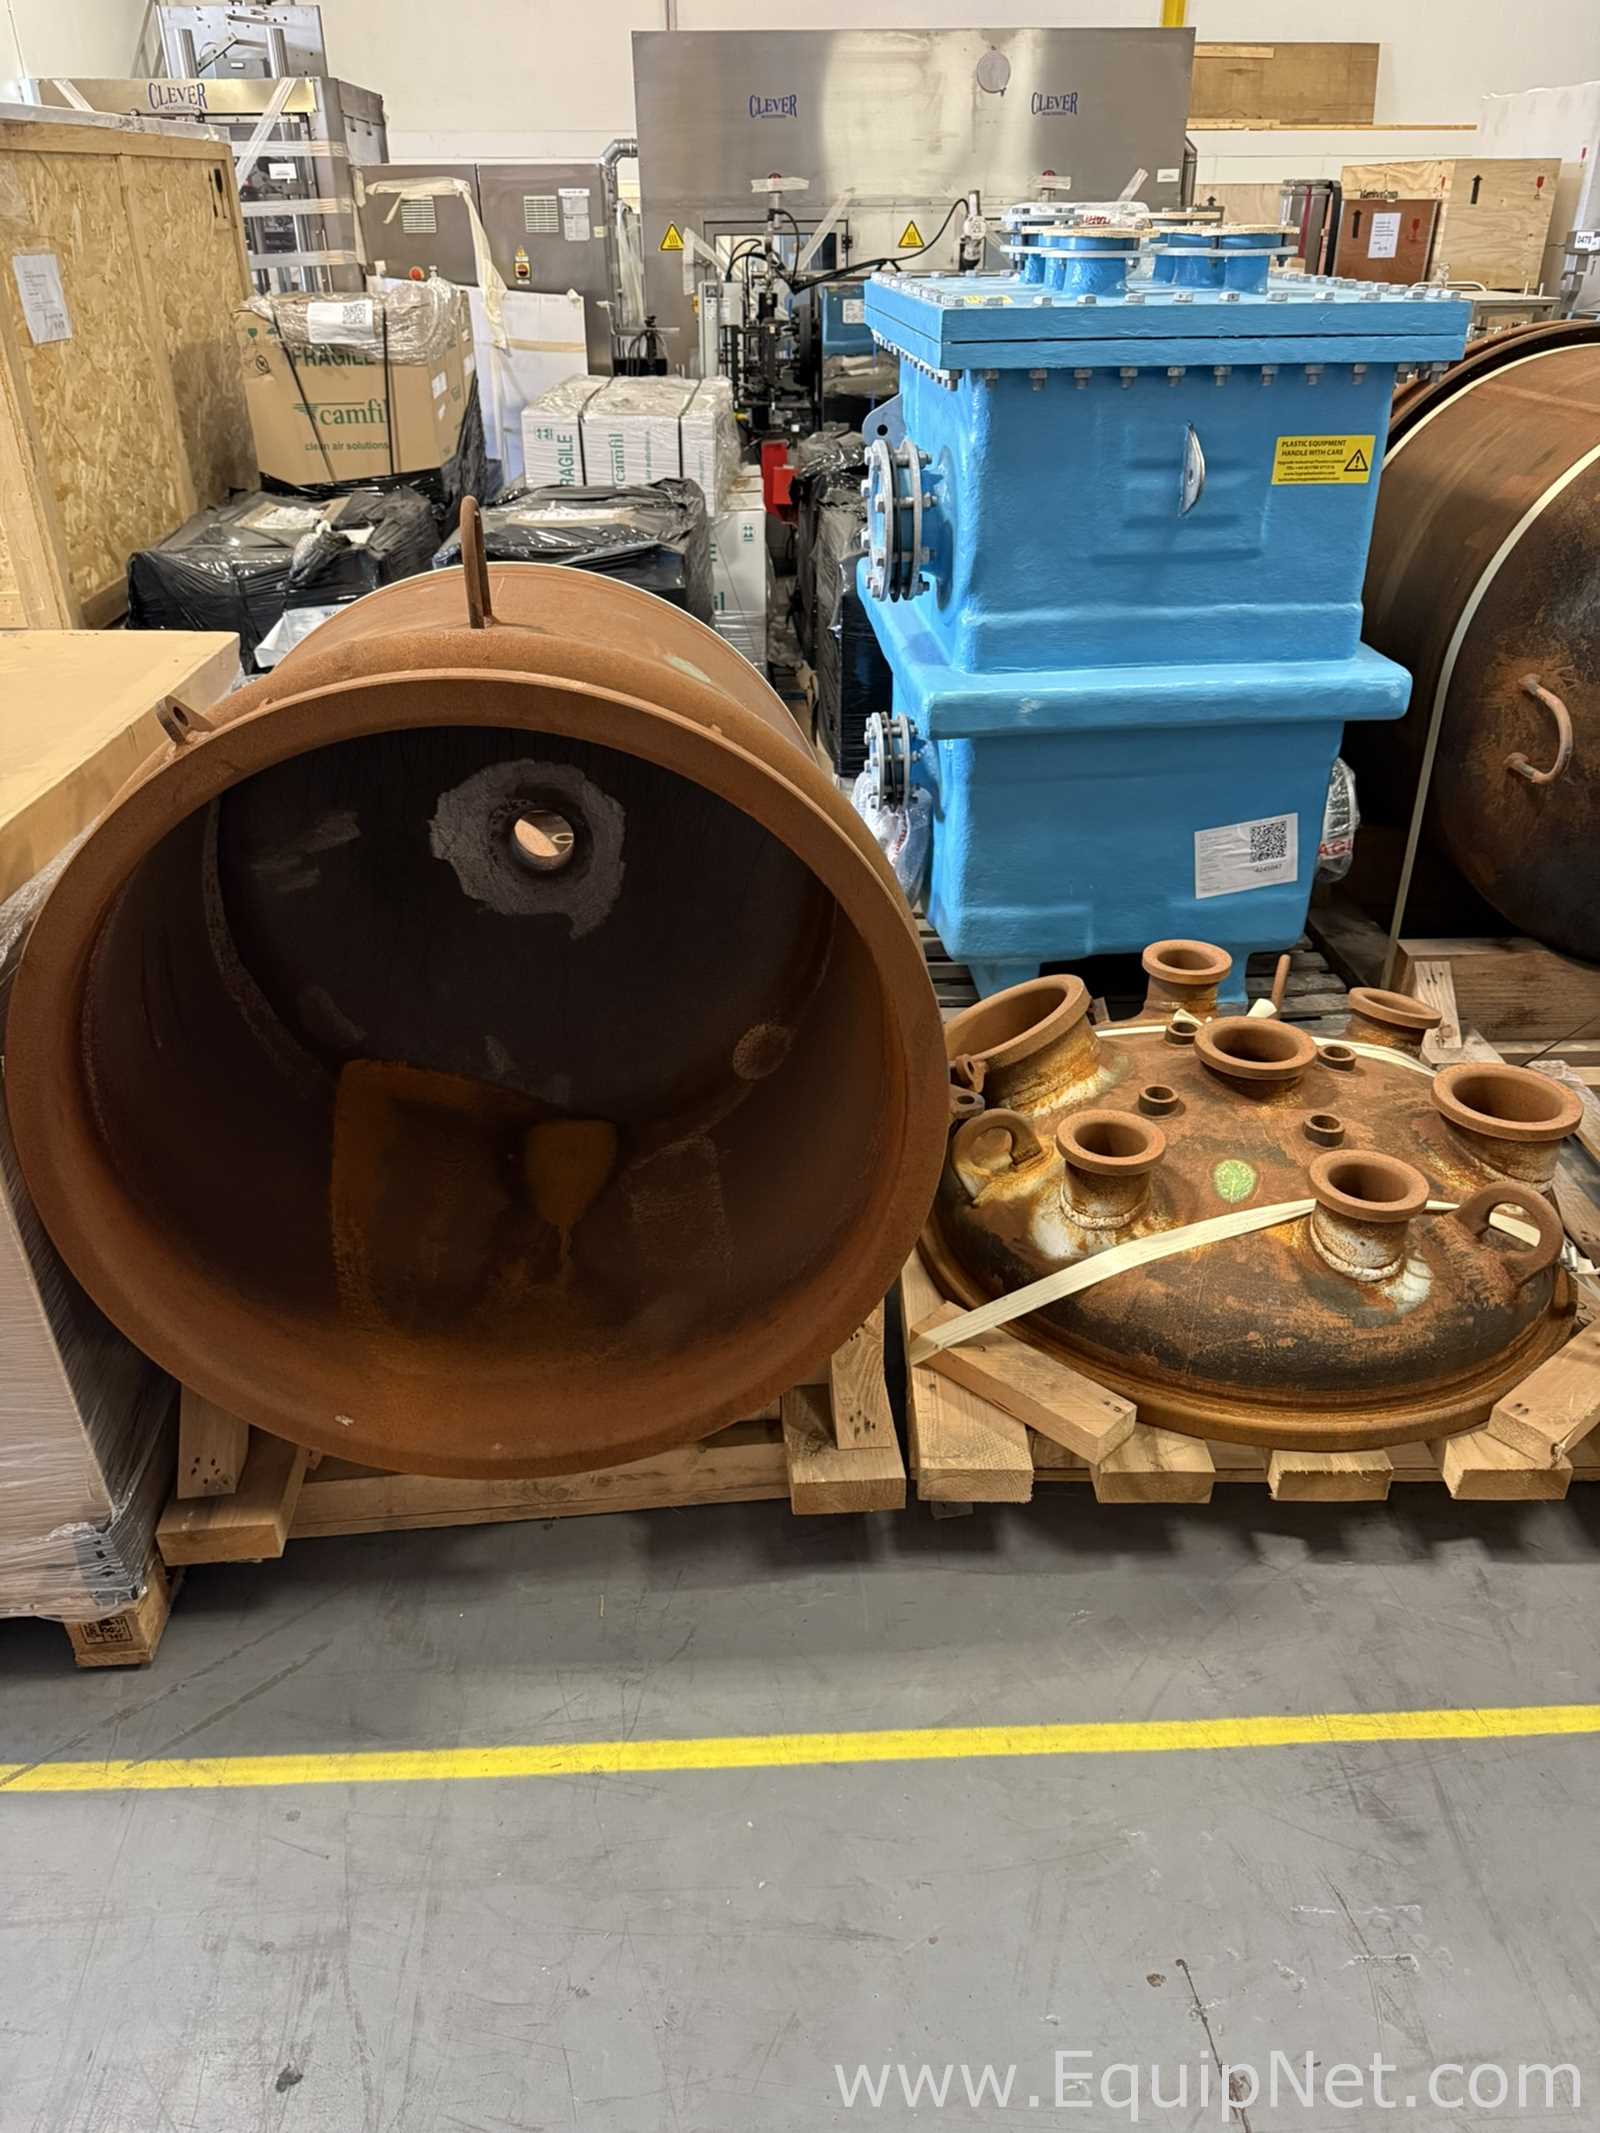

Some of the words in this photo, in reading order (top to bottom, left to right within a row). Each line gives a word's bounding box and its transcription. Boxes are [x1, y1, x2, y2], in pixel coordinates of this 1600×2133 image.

[148, 82, 208, 110] CLEVER
[749, 94, 797, 118] CLEVER
[1031, 91, 1078, 115] CLEVER
[319, 399, 391, 426] camfi
[304, 442, 330, 452] clen
[1281, 440, 1308, 448] PLASTIC
[1309, 439, 1347, 447] EQUIPMENT
[1281, 449, 1308, 457] HANDLE
[557, 434, 575, 486] RAGILE
